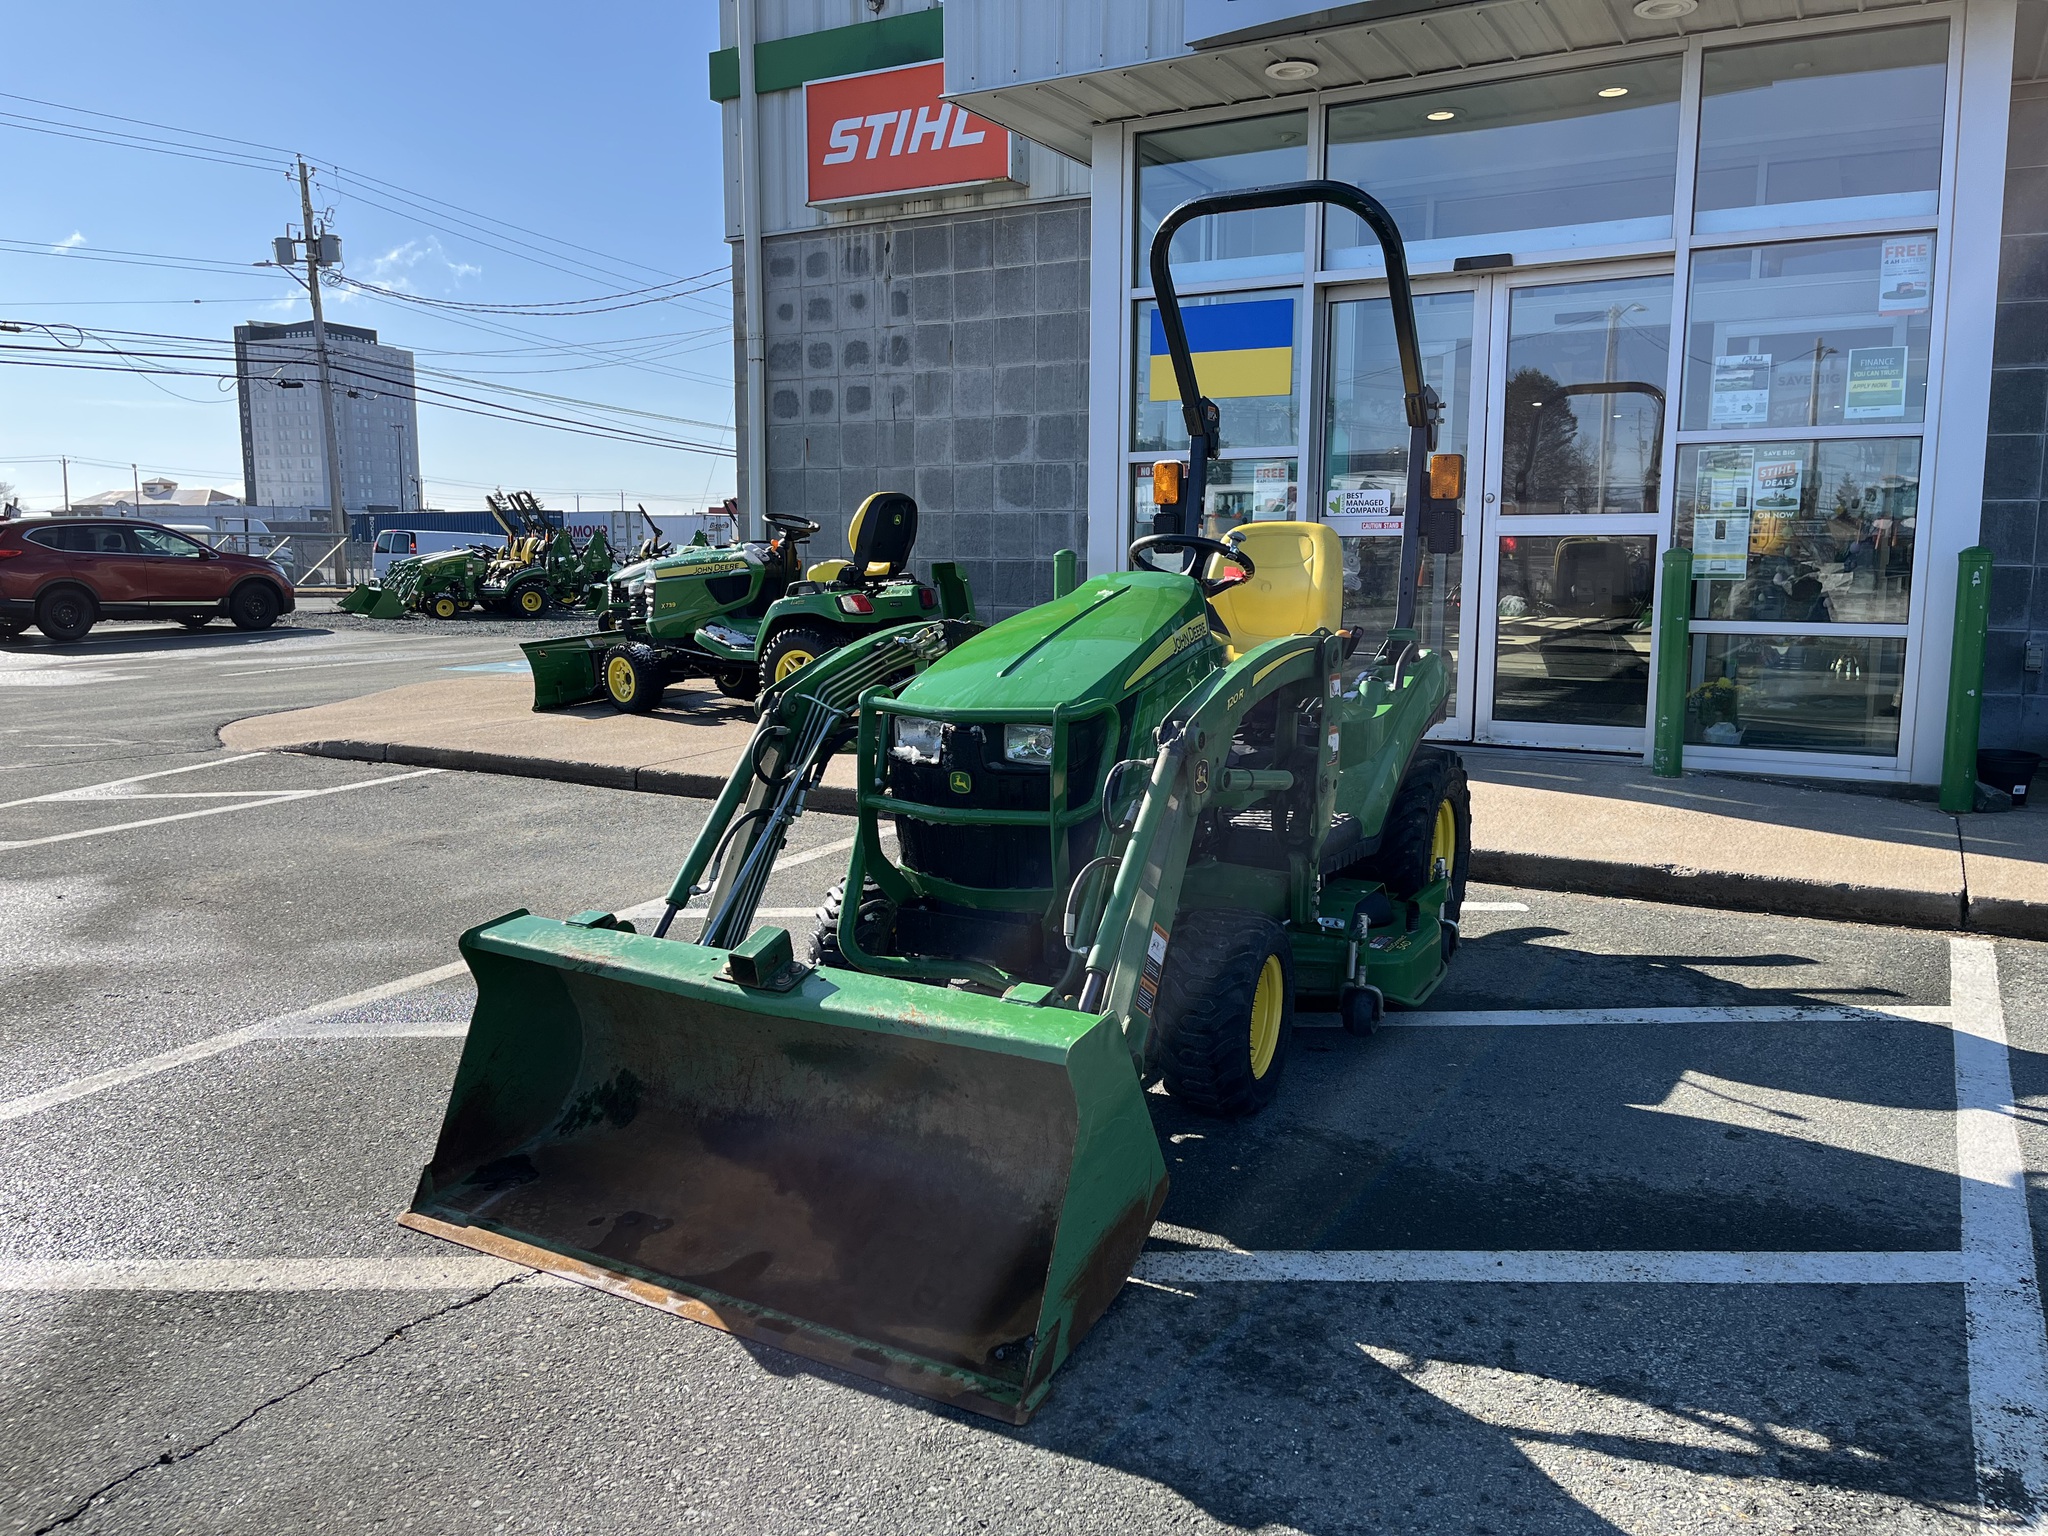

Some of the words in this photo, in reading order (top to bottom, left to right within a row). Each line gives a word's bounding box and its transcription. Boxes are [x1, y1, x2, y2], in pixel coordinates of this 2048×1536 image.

[823, 103, 986, 166] STIHL
[1884, 244, 1927, 259] FREE
[1860, 358, 1895, 367] FINANCE
[242, 393, 250, 434] TOWER
[245, 441, 253, 482] HOTEL
[1140, 466, 1151, 476] NO
[1256, 468, 1285, 479] FREE
[1760, 464, 1793, 478] STIHL
[1764, 478, 1795, 487] DEALS
[1346, 499, 1384, 507] MANAGED
[1345, 506, 1389, 514] COMPANIES
[693, 566, 713, 575] JOHN
[714, 562, 739, 572] DEERE
[1173, 633, 1191, 655] JOHN
[1187, 622, 1207, 643] DEERE
